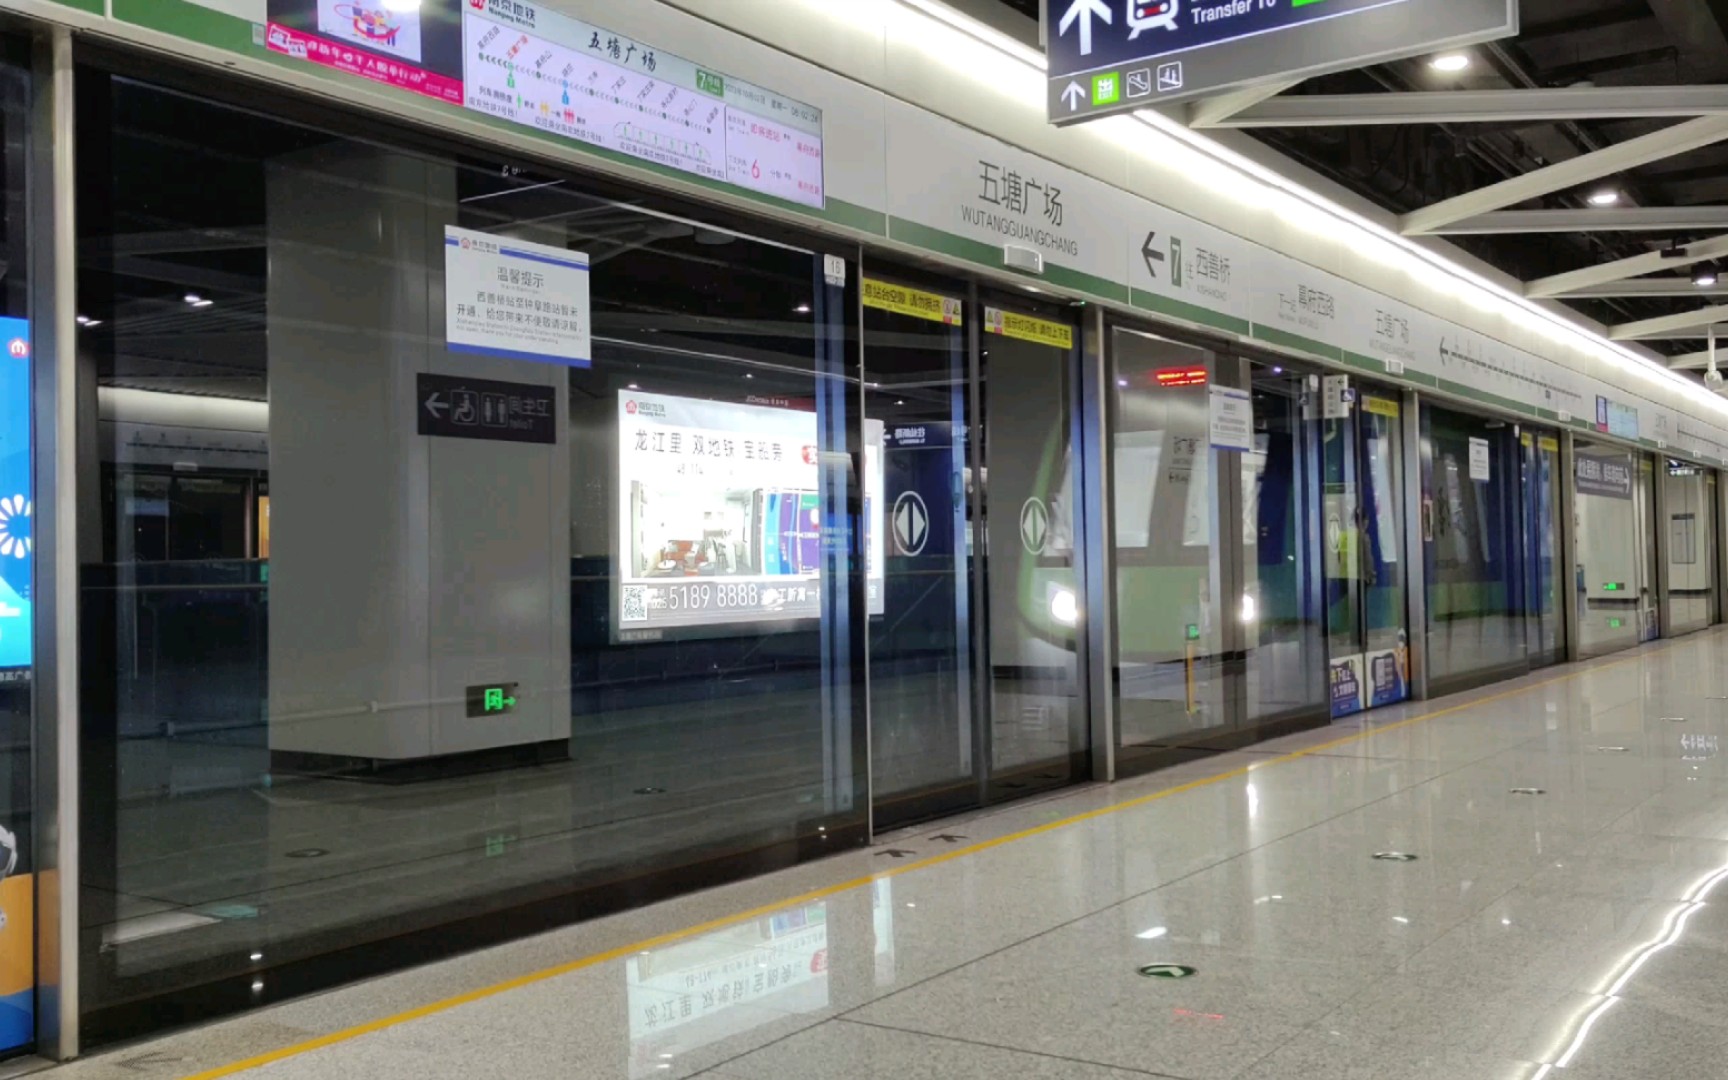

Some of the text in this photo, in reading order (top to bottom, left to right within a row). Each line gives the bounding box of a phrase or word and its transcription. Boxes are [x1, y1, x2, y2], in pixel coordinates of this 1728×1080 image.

[1190, 0, 1253, 24] Transfer
[587, 31, 657, 73] 五塘广场
[751, 159, 760, 180] 6
[977, 159, 1063, 228] 五塘广场
[961, 203, 1079, 257] WUTANGGUANGCHANG
[497, 265, 545, 289] 温馨提示
[1171, 243, 1181, 281] 7
[1195, 246, 1231, 286] 西善桥
[634, 428, 682, 454] 龙江里
[669, 585, 711, 610] 5189
[716, 583, 758, 608] 8888
